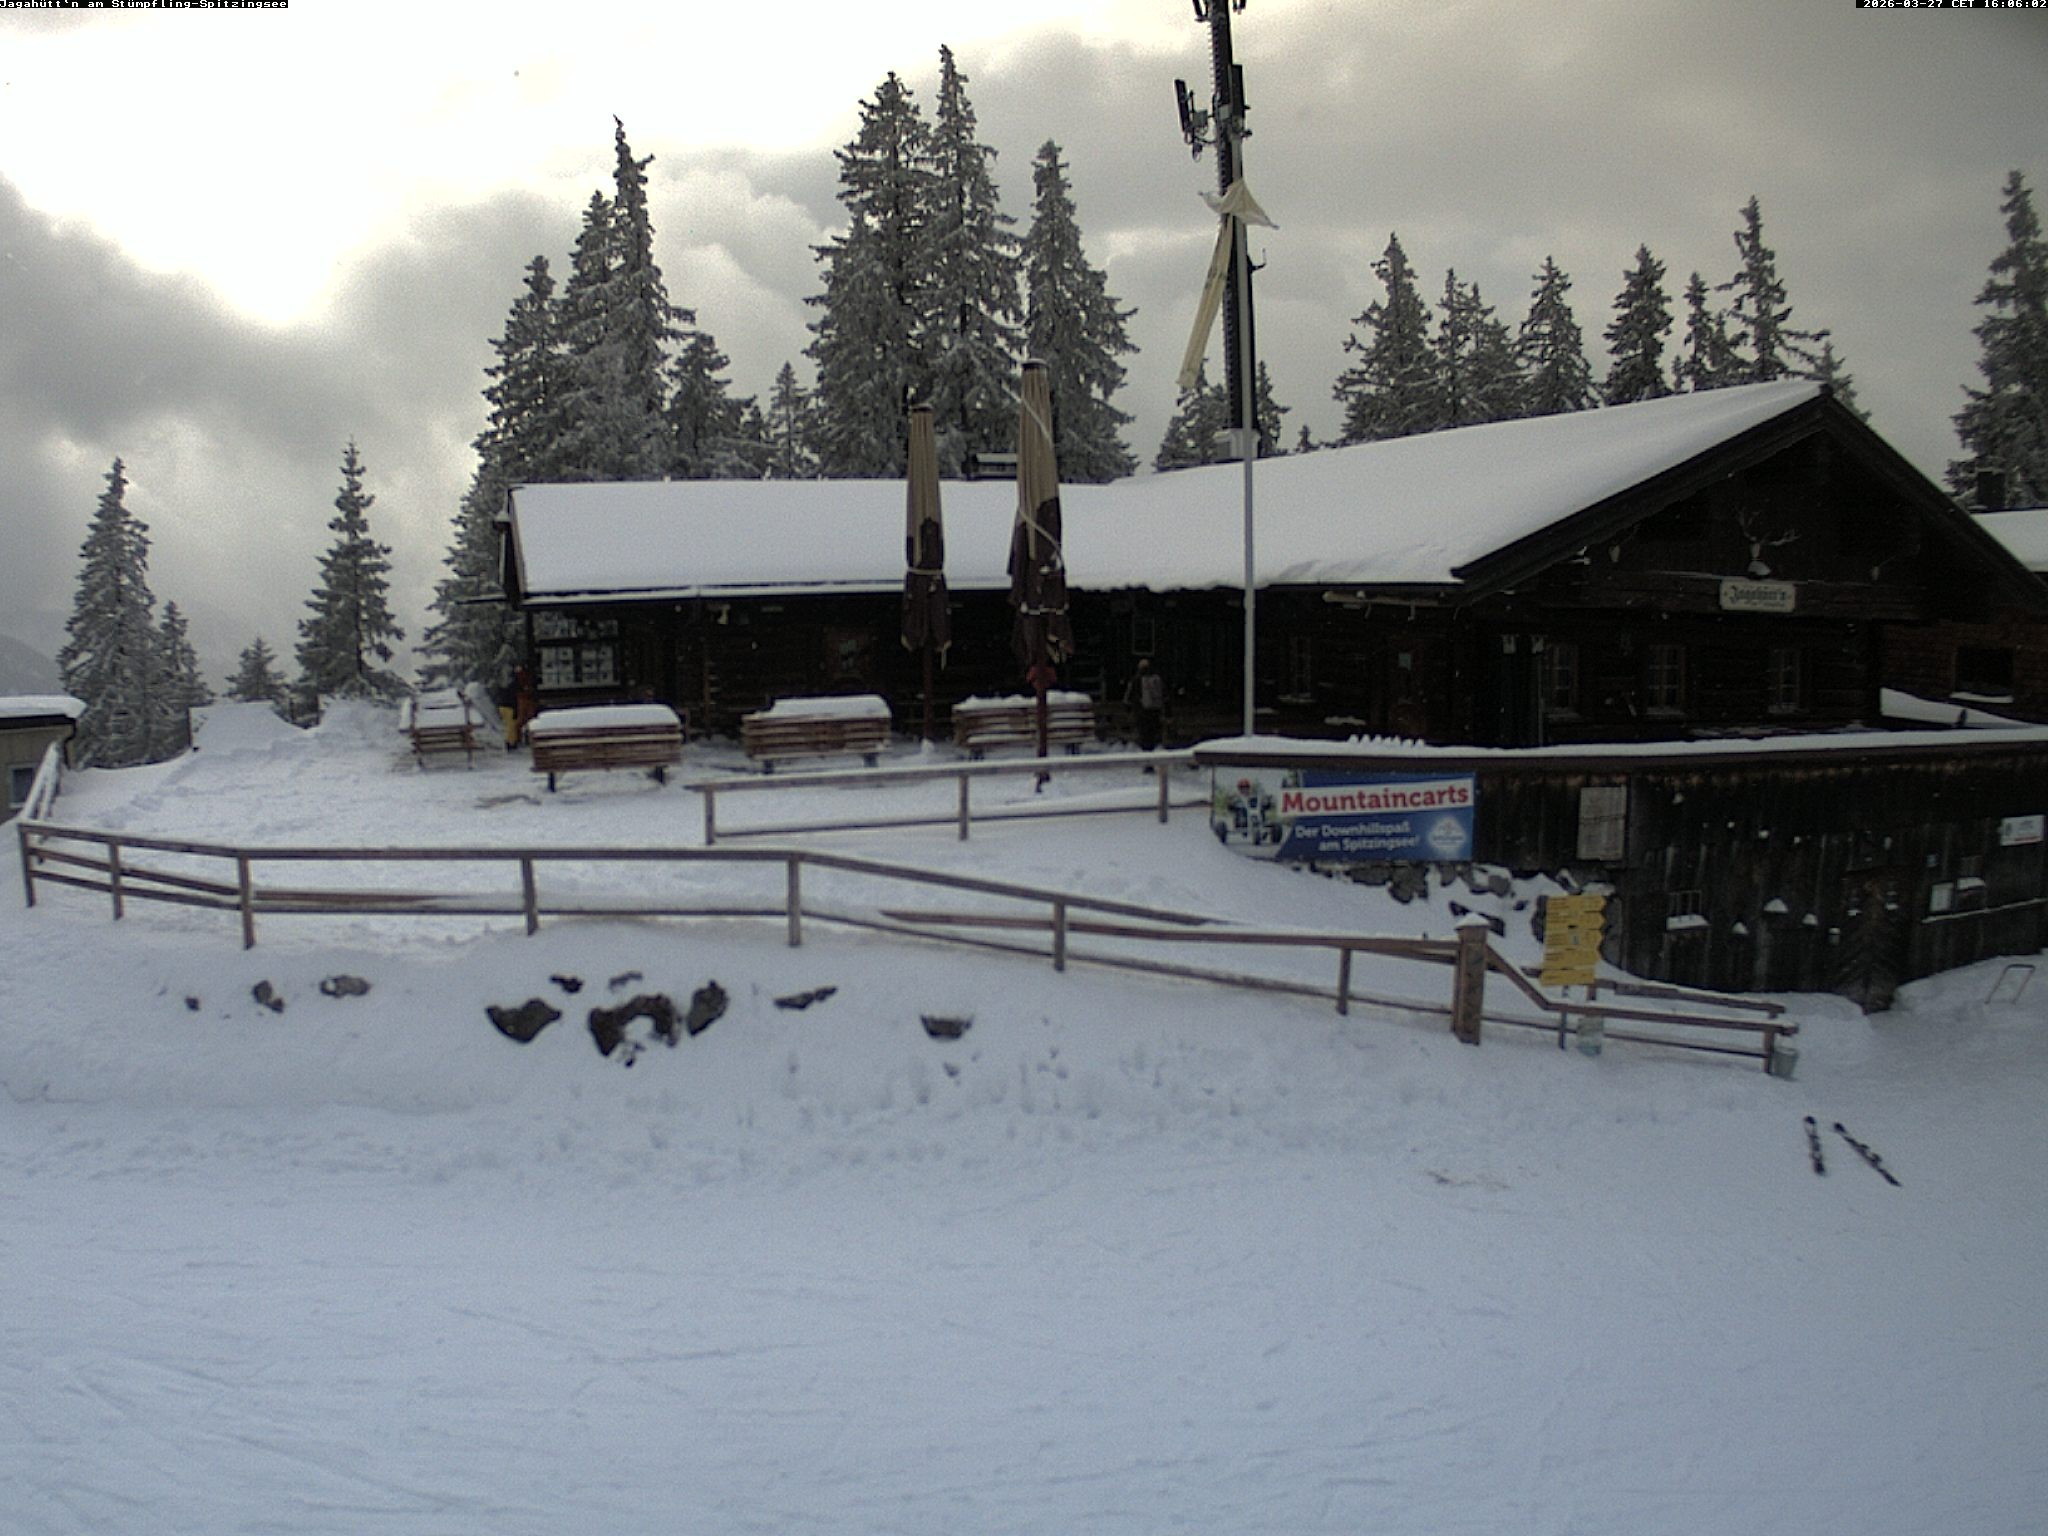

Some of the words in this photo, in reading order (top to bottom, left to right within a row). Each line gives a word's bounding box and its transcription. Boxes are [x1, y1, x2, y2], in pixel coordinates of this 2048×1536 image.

[1281, 785, 1469, 814] Mountaincarts
[1295, 825, 1319, 839] Der
[1318, 841, 1341, 852] am
